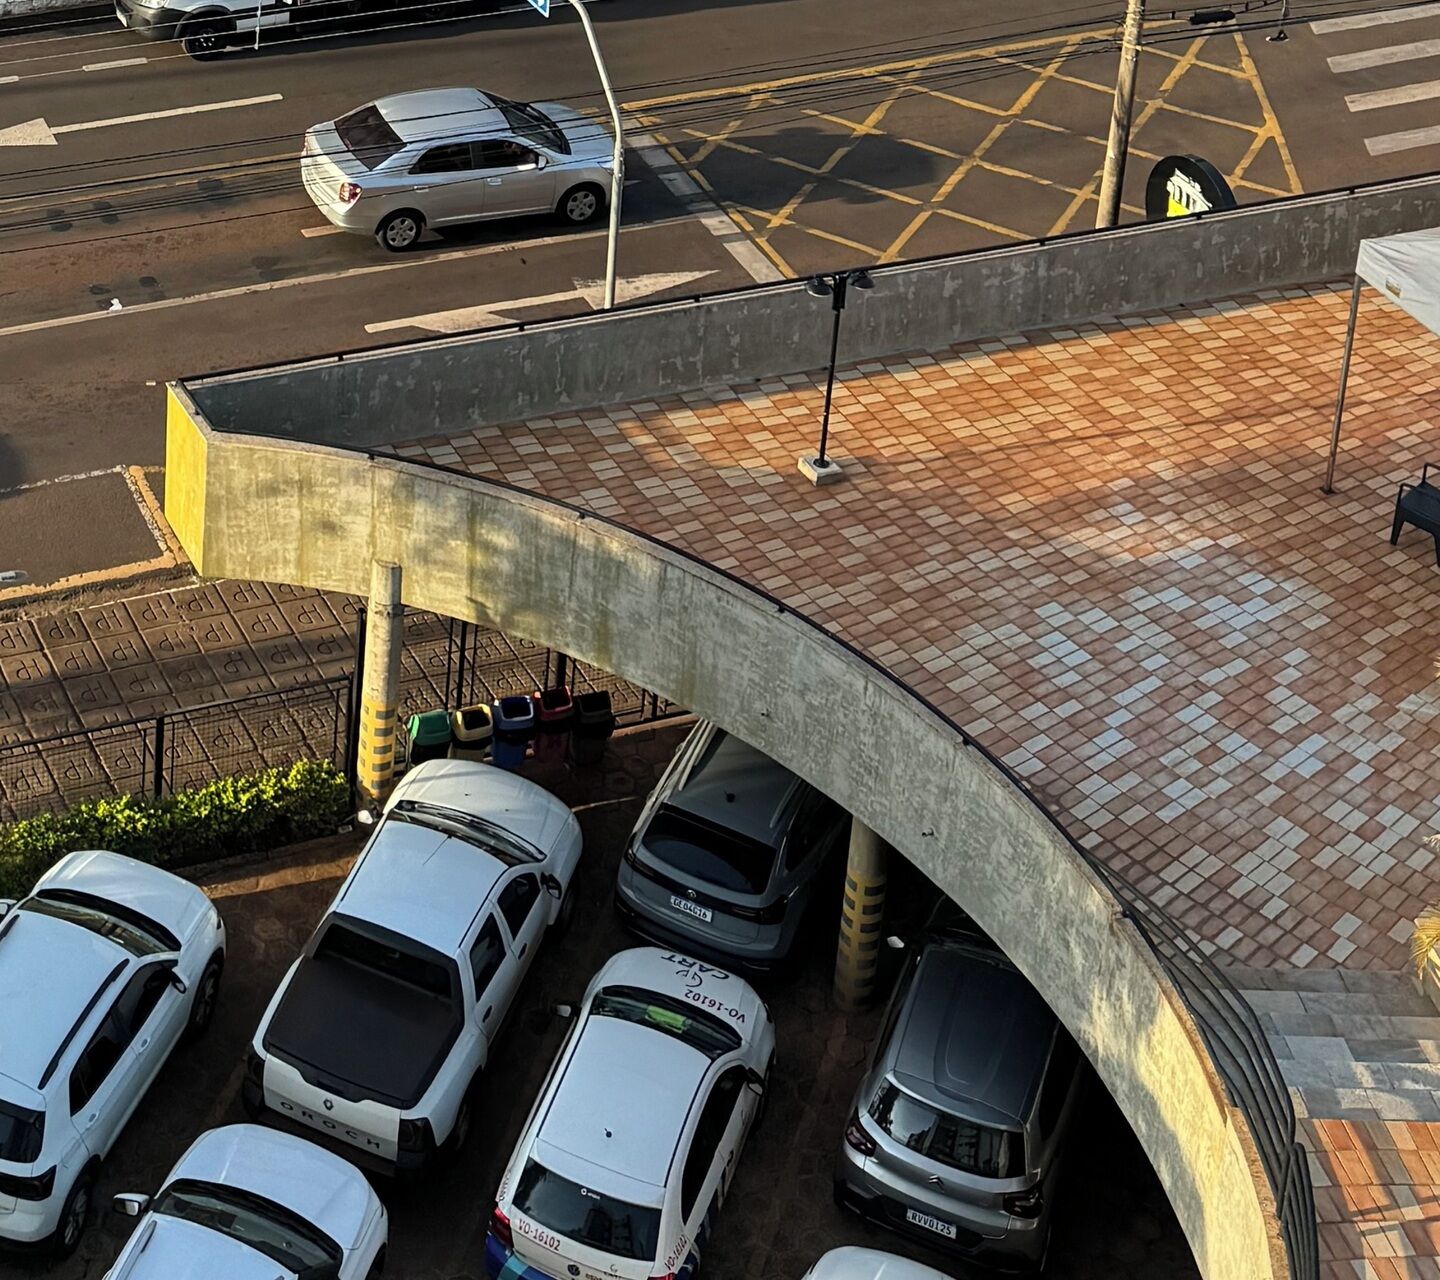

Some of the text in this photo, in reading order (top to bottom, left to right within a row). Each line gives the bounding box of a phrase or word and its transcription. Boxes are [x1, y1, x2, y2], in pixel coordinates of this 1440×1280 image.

[660, 953, 730, 981] CART
[684, 988, 746, 1023] VO-16102
[280, 1100, 380, 1149] OROCH
[518, 1218, 561, 1252] VO-16102
